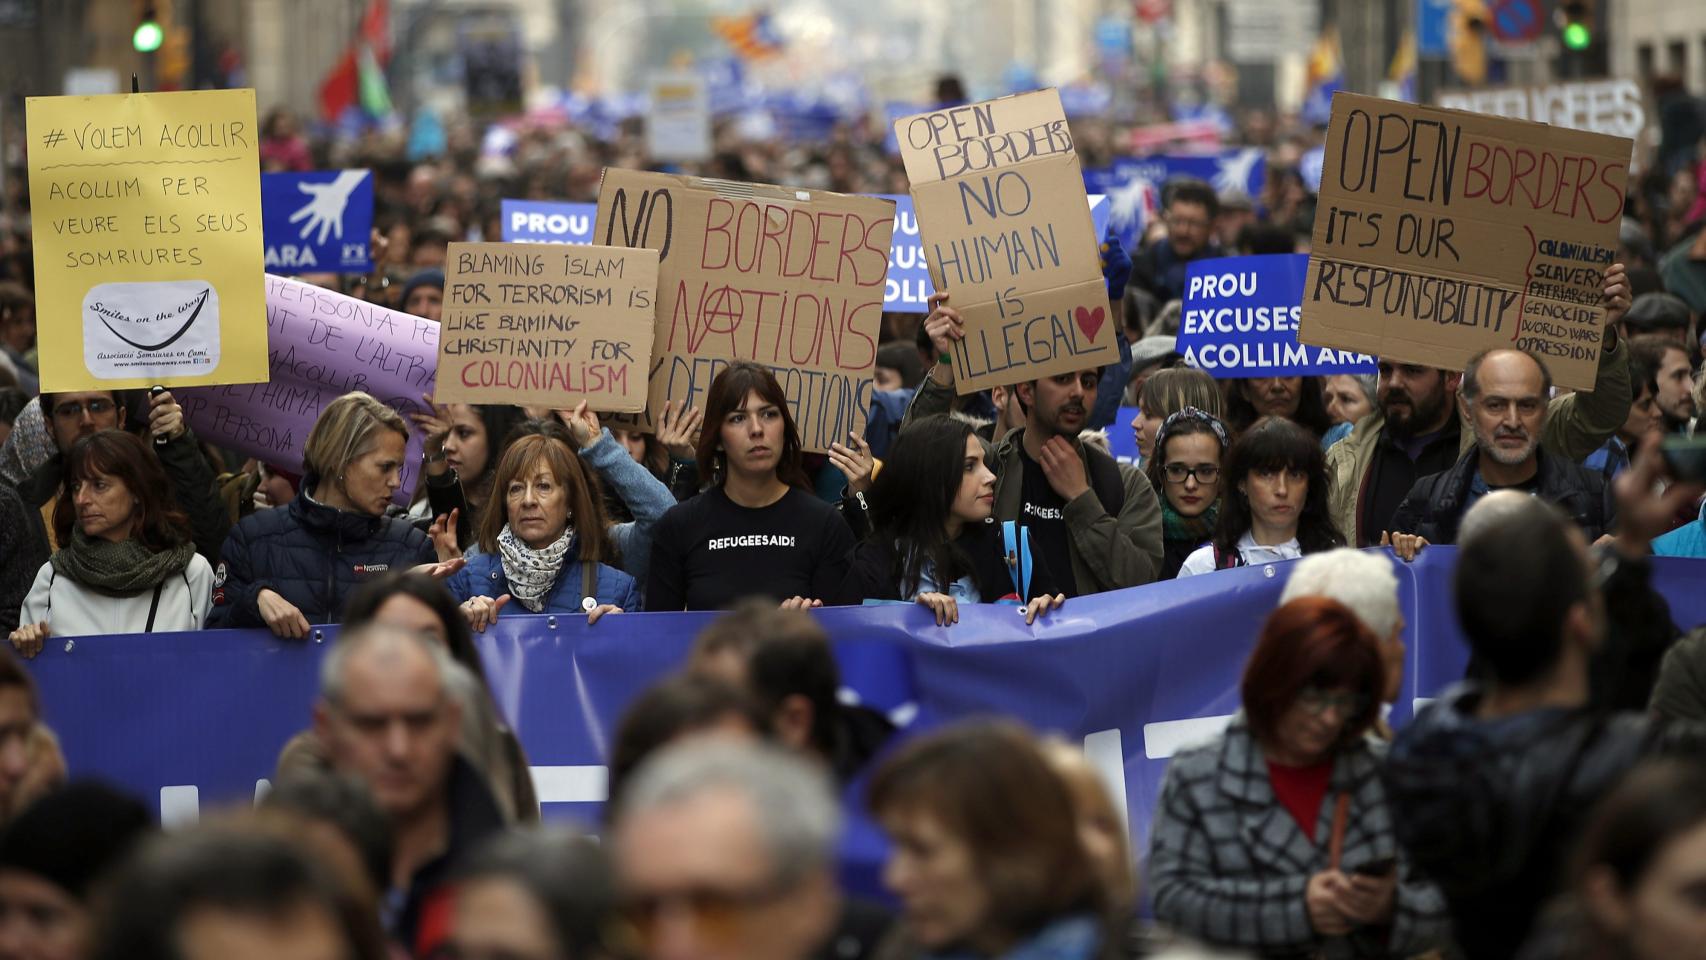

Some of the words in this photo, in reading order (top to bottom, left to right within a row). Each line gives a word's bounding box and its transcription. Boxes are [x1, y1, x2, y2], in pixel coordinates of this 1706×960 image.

[160, 121, 248, 149] ACOLLIR
[908, 104, 995, 150] OPEN
[1340, 109, 1460, 206] OPEN
[1464, 142, 1624, 224] BORDERS
[50, 177, 141, 200] ACOLLIM
[162, 176, 209, 196] PER
[959, 171, 1031, 226] NO
[53, 216, 119, 235] VEURE
[144, 214, 181, 235] ELS
[196, 213, 248, 233] SEUS
[511, 211, 590, 236] PROU
[606, 188, 672, 263] NO
[702, 199, 893, 286] BORDERS
[1326, 206, 1383, 248] IT'S
[1396, 213, 1460, 262] OUR
[66, 248, 203, 268] SOMRIURES
[265, 244, 318, 267] ARA
[935, 223, 1060, 289] HUMAN
[1538, 239, 1616, 264] COLONIALISM
[457, 252, 544, 276] BLAMING
[564, 254, 625, 279] ISLAM
[1534, 263, 1605, 288] SLAVERY
[452, 284, 491, 304] FOR
[498, 284, 612, 307] TERRORISM
[628, 286, 650, 308] IS
[1189, 272, 1257, 300] PROU
[1313, 260, 1519, 332] RESPONSIBILITY
[1529, 281, 1604, 306] PATRIARCHY
[90, 302, 130, 323] Smiles
[155, 311, 174, 322] the
[178, 296, 200, 314] Way
[270, 279, 399, 335] PERSONA
[996, 287, 1024, 319] IS
[1524, 301, 1600, 326] GENOCIDE
[447, 311, 490, 331] LIKE
[497, 310, 581, 333] BLAMING
[668, 280, 882, 370] NATIONS
[1184, 306, 1302, 334] EXCUSES
[1521, 320, 1567, 337] WORLD
[1569, 327, 1600, 343] WARS
[308, 318, 344, 351] DE
[953, 309, 1107, 379] ILLEGAL
[444, 336, 577, 358] CHRISTIANITY
[591, 340, 634, 363] FOR
[1184, 343, 1309, 369] ACOLLIM
[1316, 347, 1374, 366] ARA
[1516, 337, 1597, 361] OPRESSION
[461, 358, 628, 397] COLONIALISM
[212, 405, 293, 452] PERSONA
